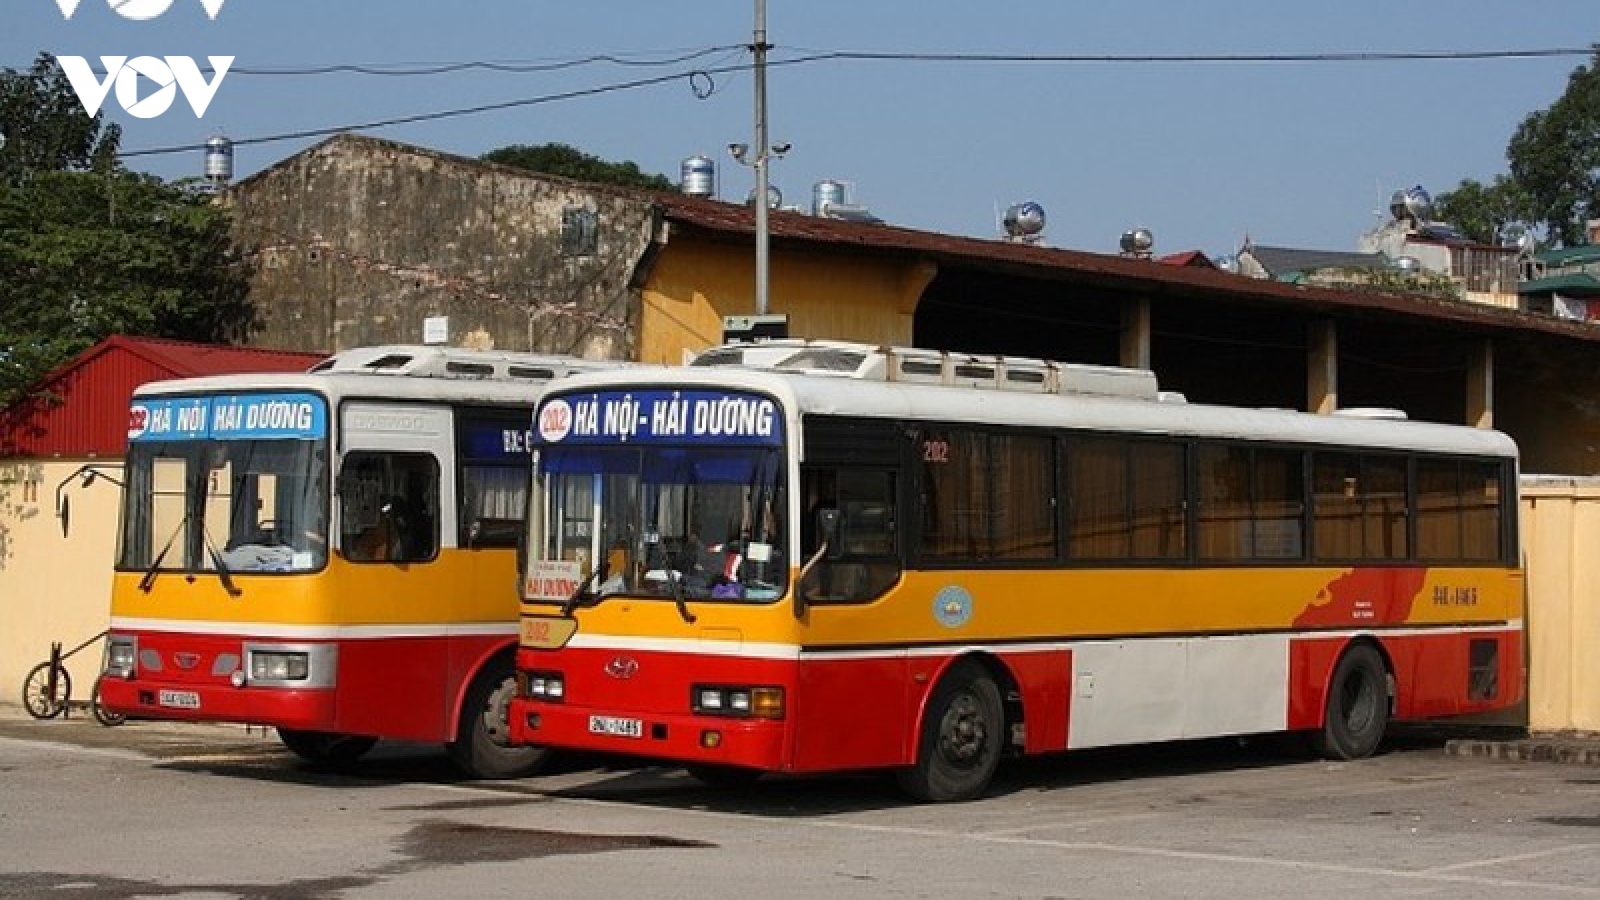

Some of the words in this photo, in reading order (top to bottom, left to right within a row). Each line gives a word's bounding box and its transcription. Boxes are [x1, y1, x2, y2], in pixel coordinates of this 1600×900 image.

[177, 400, 207, 438] NỘI
[213, 396, 242, 431] HẢI
[246, 400, 312, 430] DƯƠNG
[543, 407, 567, 431] 202
[652, 390, 689, 436] HẢI
[694, 396, 773, 436] DƯƠNG
[924, 441, 948, 462] 202
[525, 621, 549, 642] 202
